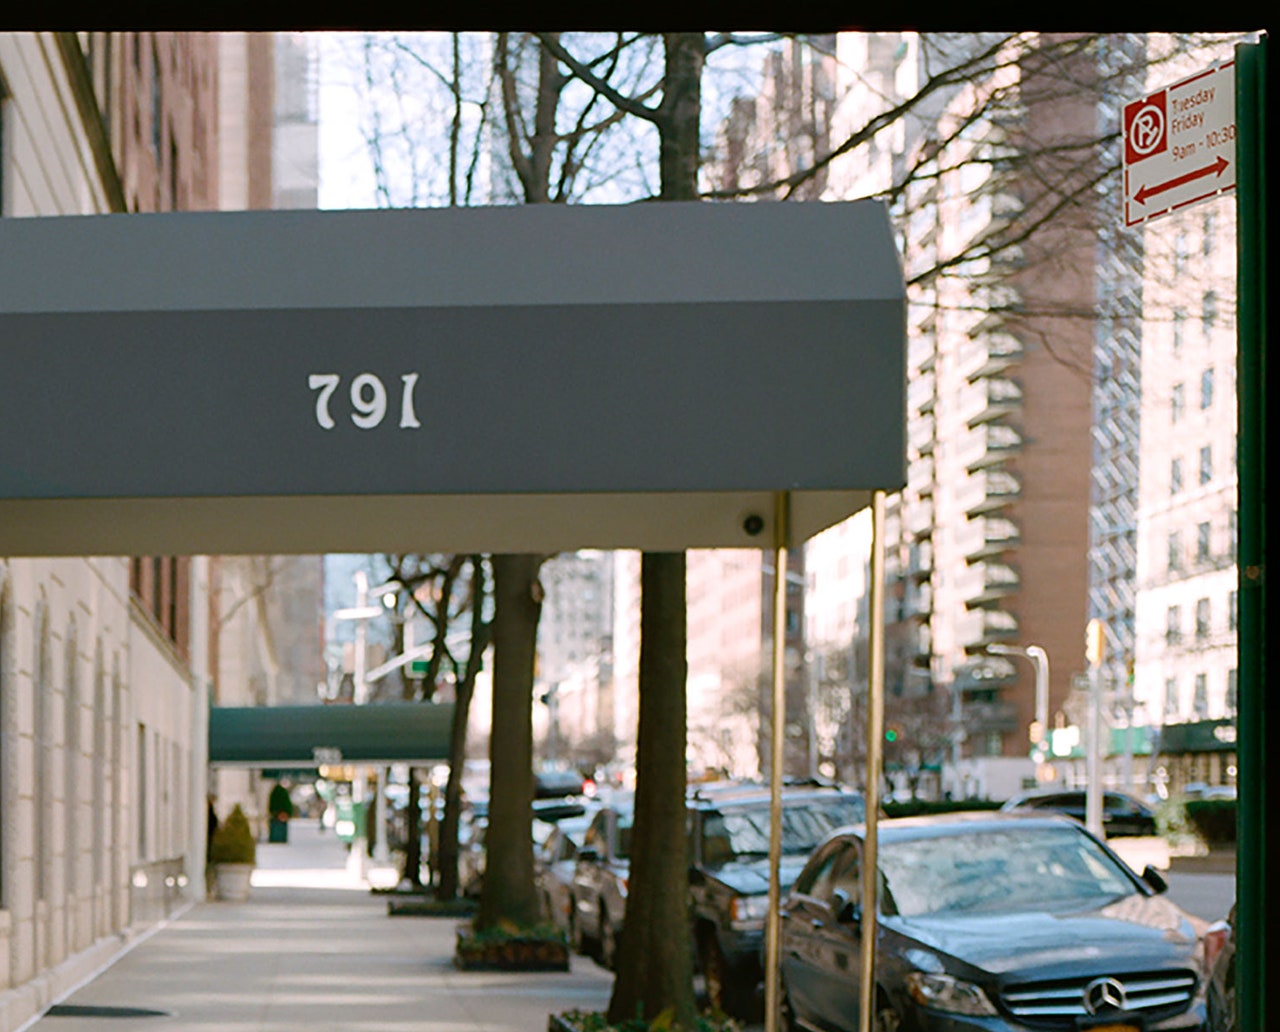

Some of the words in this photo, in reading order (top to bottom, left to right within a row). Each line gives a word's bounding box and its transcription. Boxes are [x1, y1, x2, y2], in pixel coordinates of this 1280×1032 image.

[1172, 87, 1215, 114] Tuesday
[1171, 112, 1204, 135] Friday
[1172, 143, 1196, 161] 9am
[308, 372, 421, 430] 791
